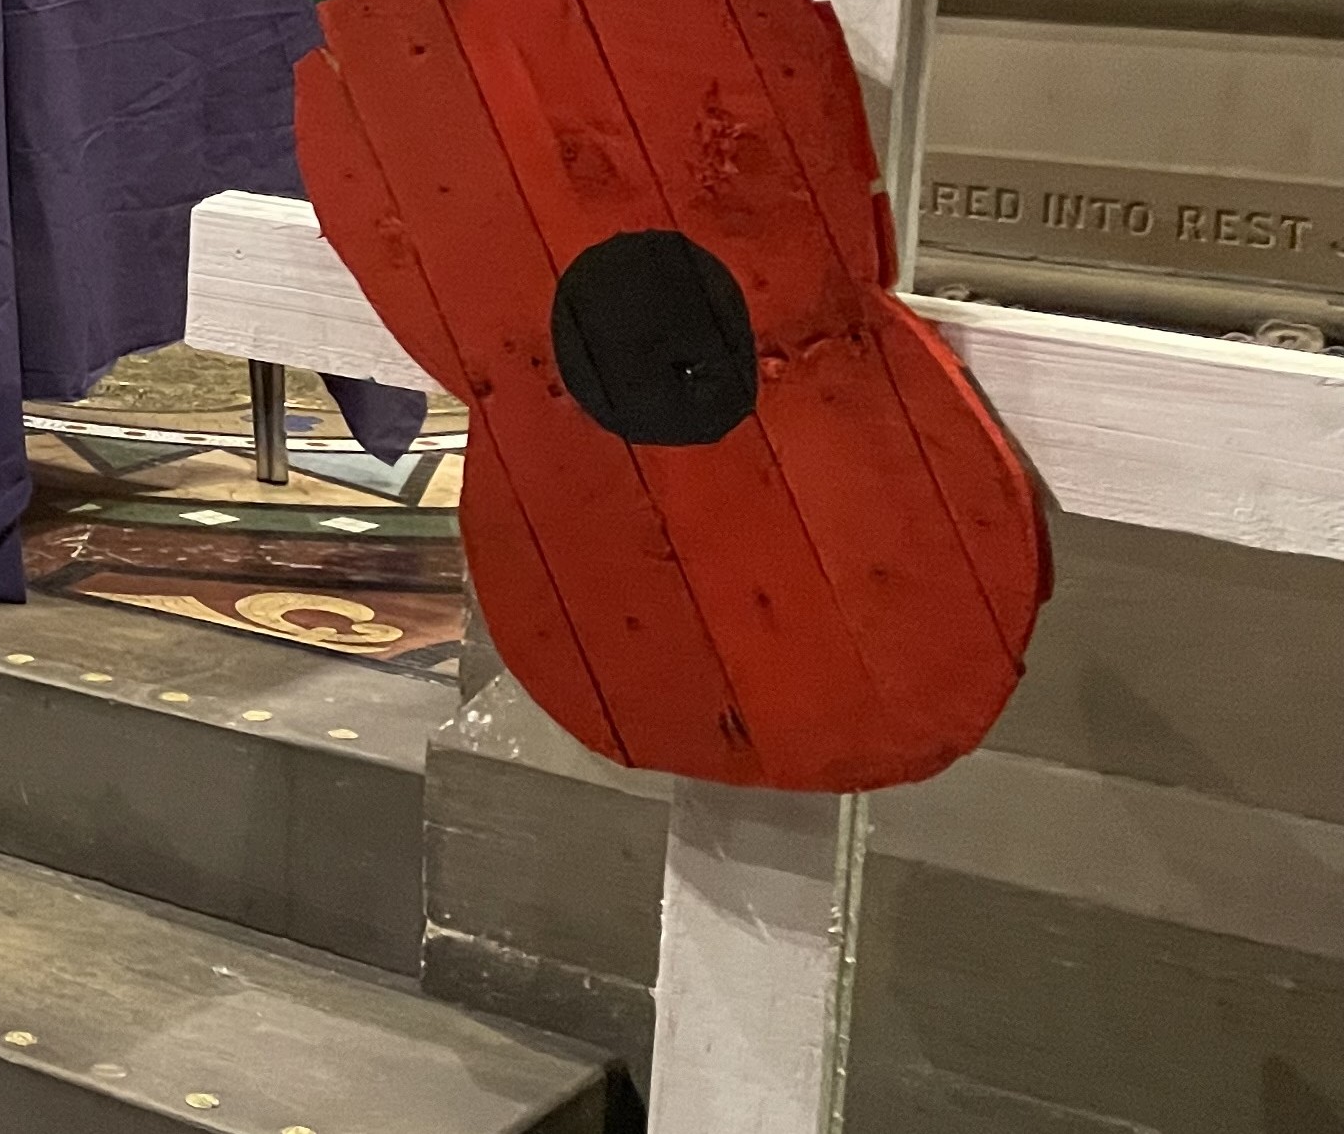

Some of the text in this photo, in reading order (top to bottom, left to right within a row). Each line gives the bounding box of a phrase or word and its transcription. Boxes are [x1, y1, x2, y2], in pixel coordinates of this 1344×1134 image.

[919, 181, 1023, 224] RED
[1043, 192, 1155, 236] INTO
[1177, 205, 1312, 252] REST
